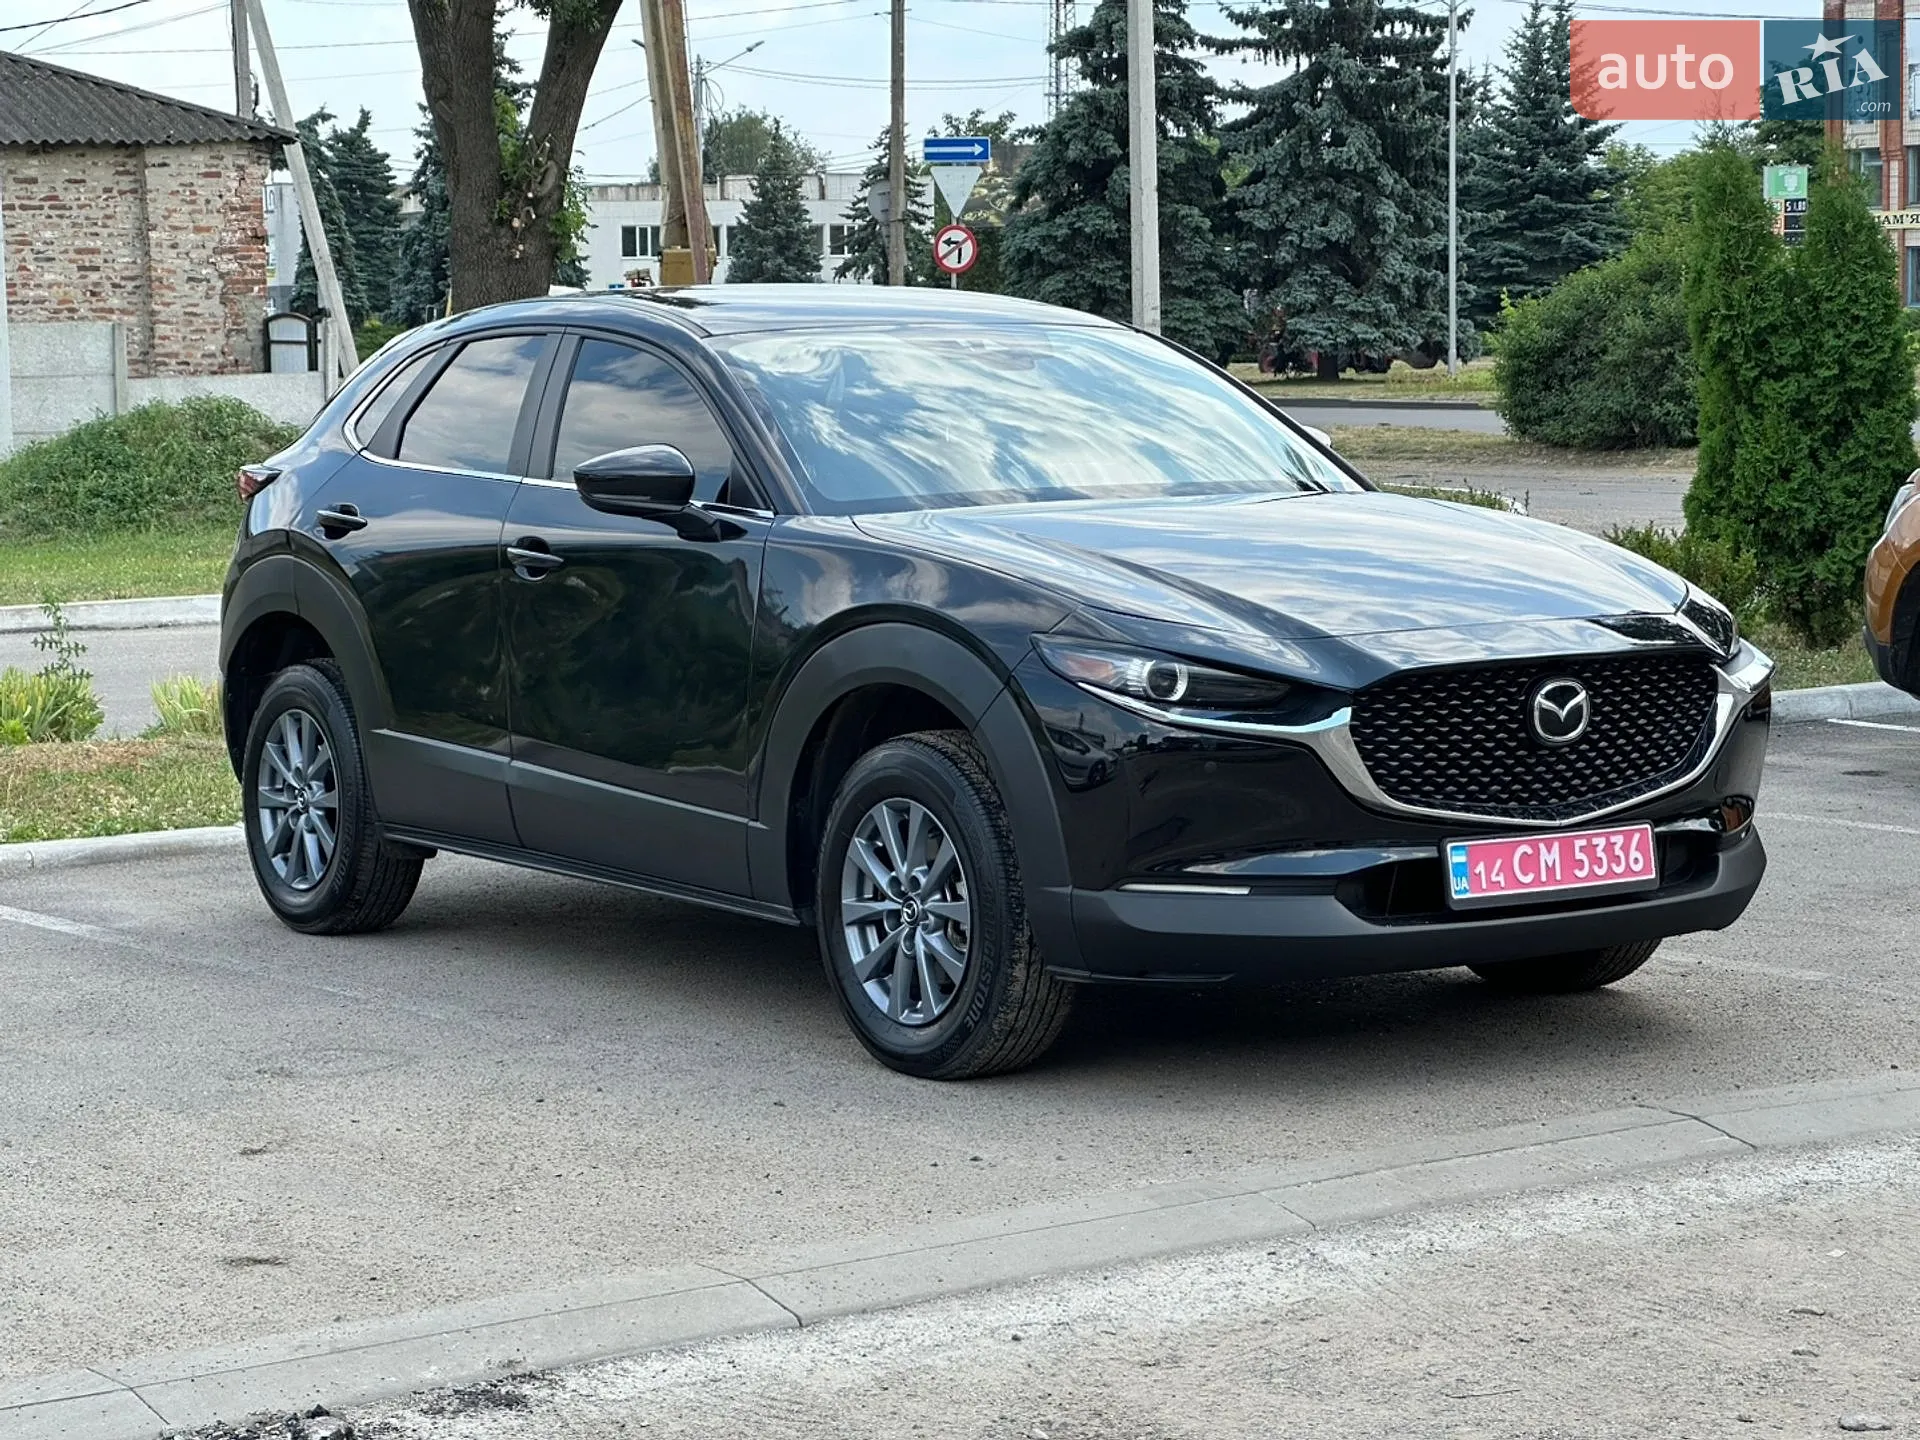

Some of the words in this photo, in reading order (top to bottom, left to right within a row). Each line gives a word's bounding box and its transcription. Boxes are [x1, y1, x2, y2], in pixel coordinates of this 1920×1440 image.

[1453, 877, 1470, 891] UA
[1474, 859, 1505, 890] 14
[1512, 841, 1562, 884] CM
[1573, 832, 1645, 878] 5336
